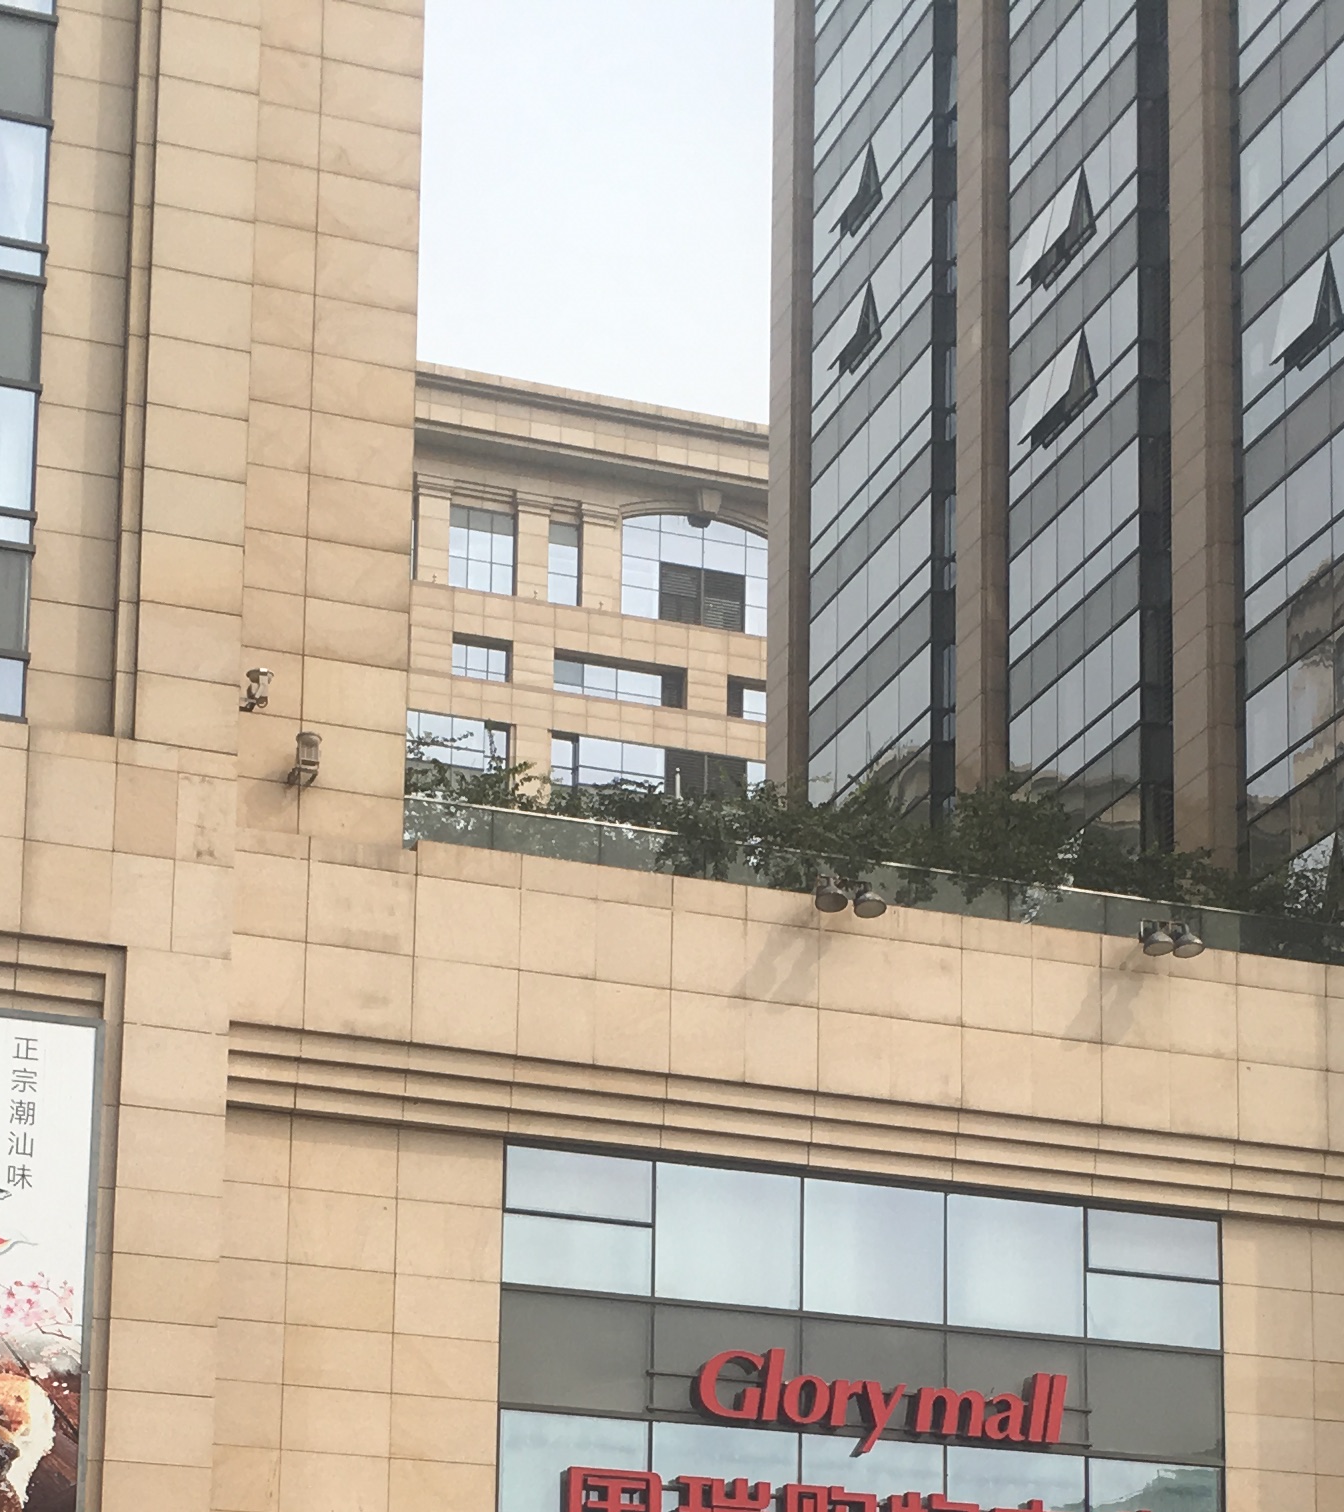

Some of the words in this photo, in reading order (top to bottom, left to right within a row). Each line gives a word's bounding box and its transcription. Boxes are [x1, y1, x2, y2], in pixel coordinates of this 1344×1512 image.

[7, 1036, 39, 1190] 正宗潮汕味
[692, 1348, 905, 1456] Glory
[914, 1372, 1069, 1444] mall
